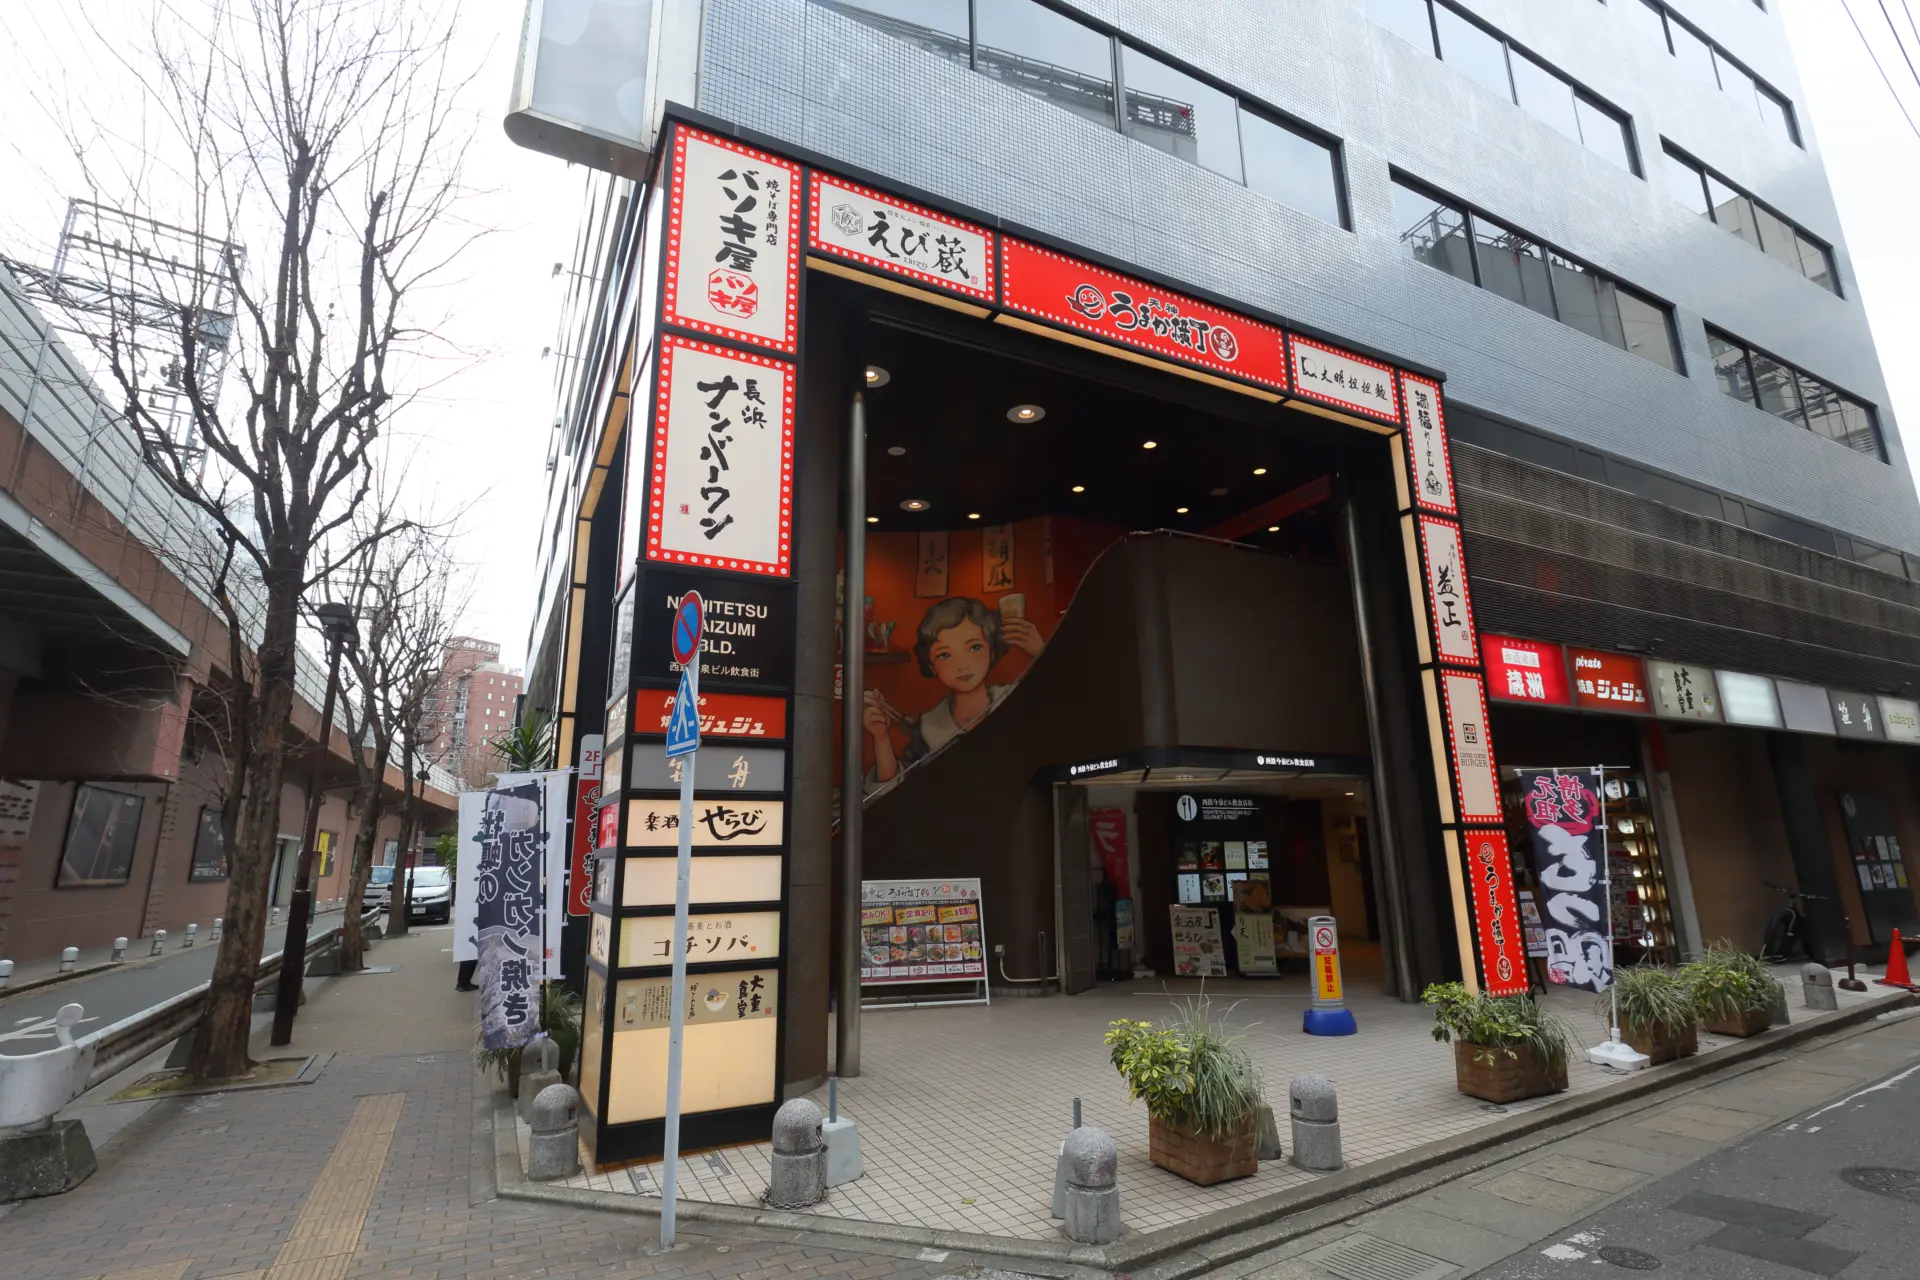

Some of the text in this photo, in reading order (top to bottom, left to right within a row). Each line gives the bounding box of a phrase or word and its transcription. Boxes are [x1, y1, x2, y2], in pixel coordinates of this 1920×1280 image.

[765, 179, 781, 246] 焼そば専門店
[867, 210, 970, 280] えび蔵
[903, 256, 928, 271] EBIZO
[1148, 298, 1179, 315] 天神
[1108, 291, 1211, 354] うまか横丁
[742, 379, 767, 429] 長浜
[696, 375, 739, 540] ナンバーワン
[667, 595, 768, 619] NHITETSU
[1437, 564, 1461, 627] 益正
[703, 619, 756, 637] AIZUMI
[700, 639, 736, 655] BLD.
[669, 661, 760, 678] 西泉ビル飲食街
[1575, 655, 1603, 671] pirate
[1576, 678, 1646, 703] 焼鳥ジュジュ
[660, 714, 765, 735] 焼ジュジュ
[1888, 712, 1915, 728] sobaya
[584, 750, 600, 762] 2F
[1460, 759, 1489, 767] BURGER
[699, 806, 768, 841] せらび
[1485, 865, 1505, 957] うまか横丁
[737, 980, 749, 1019] 食堂
[750, 974, 764, 1013] 大重
